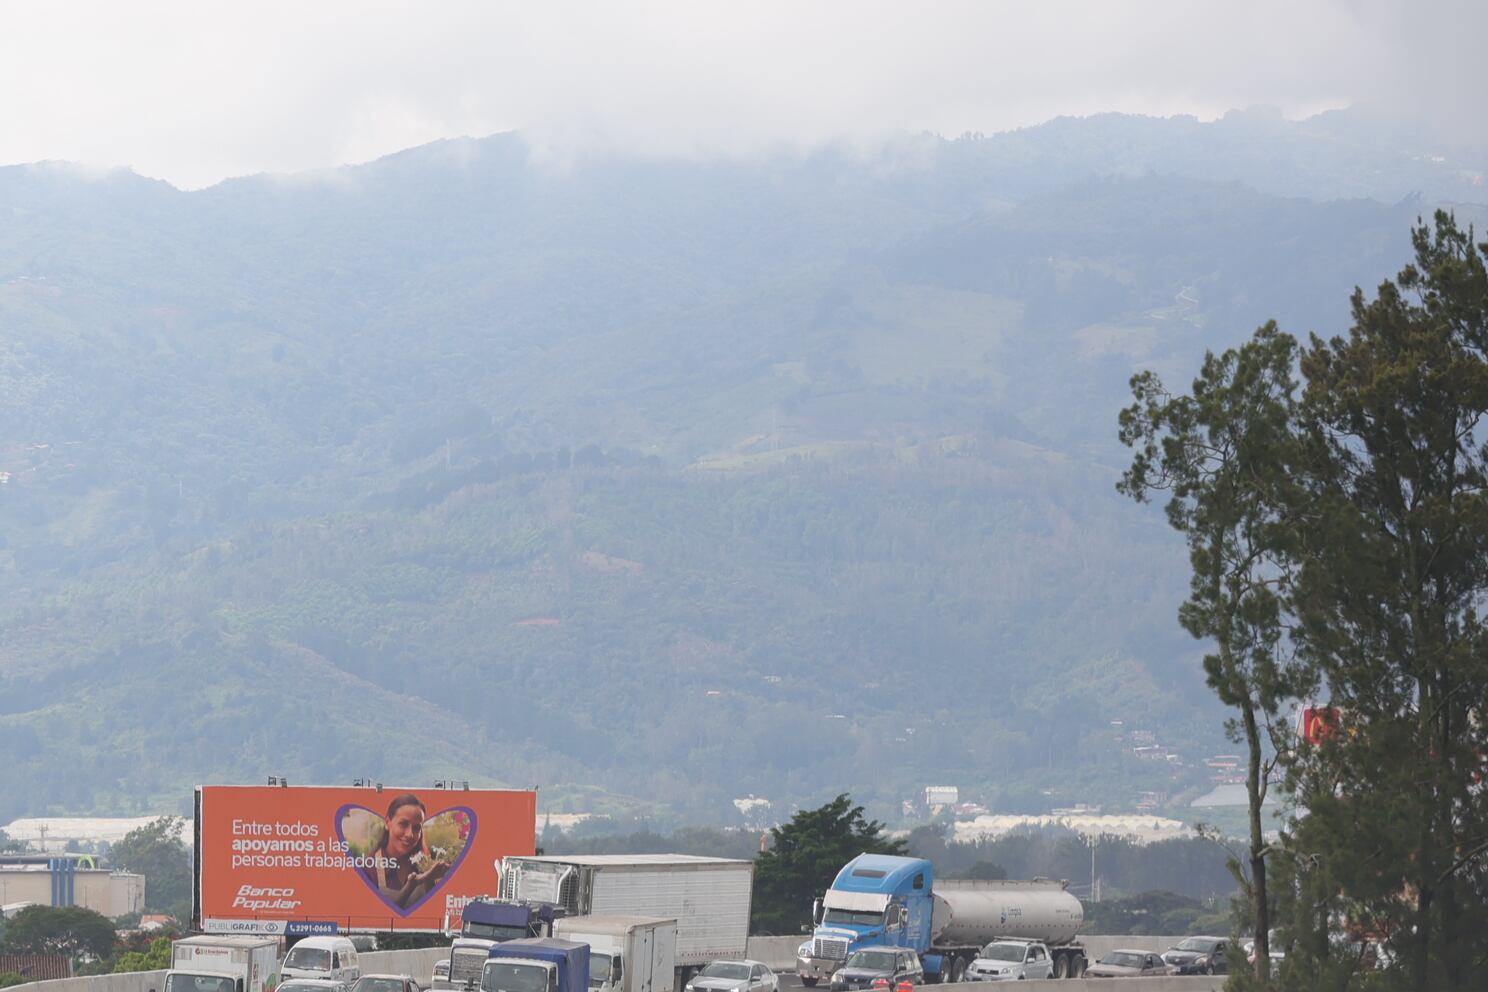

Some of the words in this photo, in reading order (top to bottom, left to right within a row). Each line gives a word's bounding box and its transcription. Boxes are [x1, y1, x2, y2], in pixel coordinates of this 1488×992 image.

[232, 820, 272, 836] Entre
[276, 821, 318, 836] todos
[232, 838, 313, 854] apoyamos
[317, 842, 325, 851] a
[329, 837, 349, 852] las
[232, 853, 300, 869] personas
[304, 853, 400, 871] trabajadoras.
[238, 884, 295, 897] Banco
[232, 897, 302, 911] Popular
